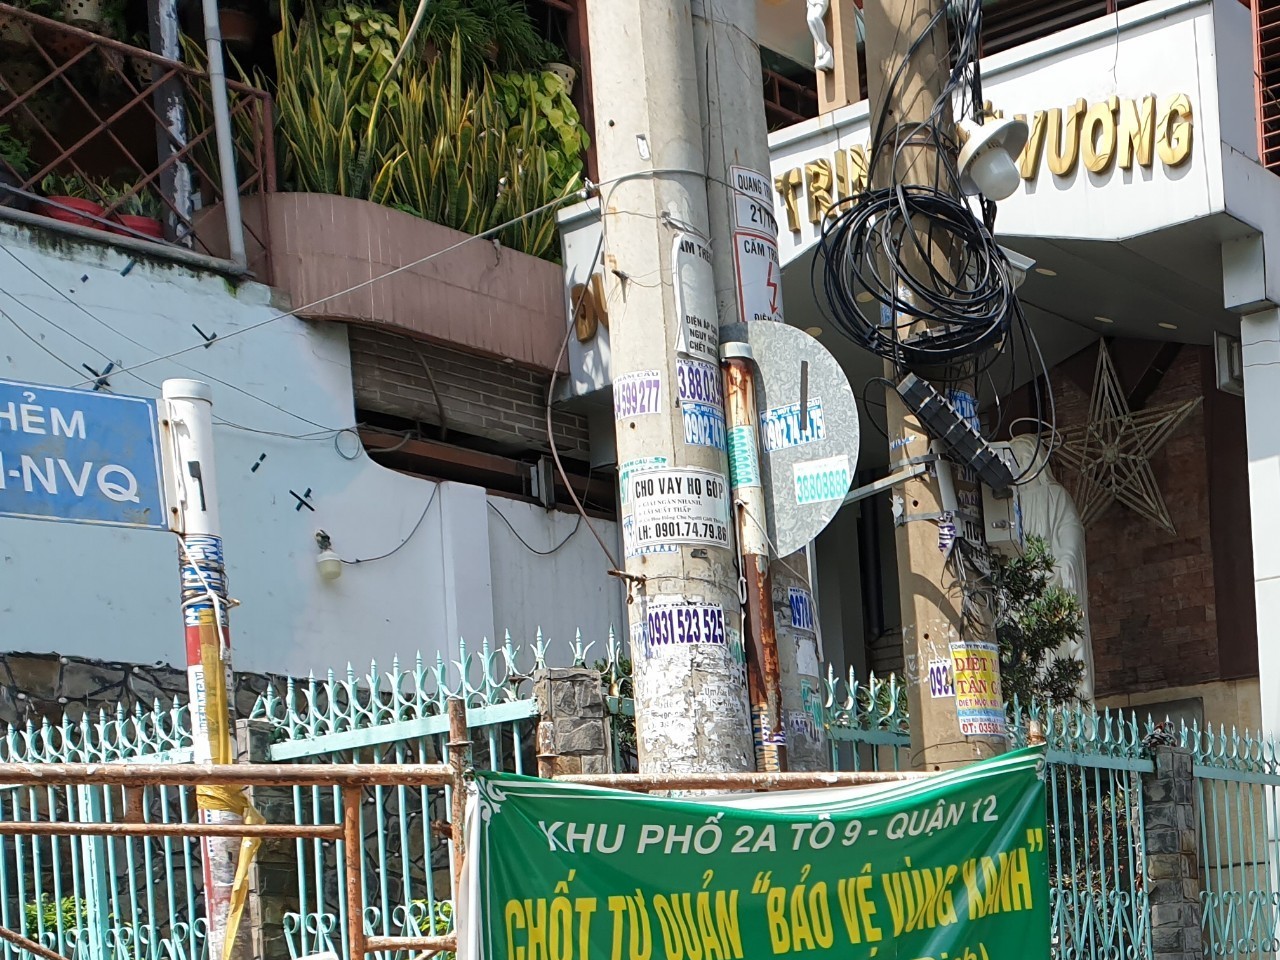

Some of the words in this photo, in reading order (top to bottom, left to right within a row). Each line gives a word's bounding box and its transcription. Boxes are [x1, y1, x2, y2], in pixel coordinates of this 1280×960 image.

[635, 479, 654, 498] CHO
[658, 477, 682, 495] VAY
[687, 478, 702, 499] HỌ
[706, 478, 723, 500] GÓP
[638, 525, 652, 540] LH:
[954, 653, 988, 674] DIỆT
[956, 676, 988, 697] TẬN
[538, 820, 626, 854] KHU
[636, 812, 725, 855] PHỐ
[731, 824, 777, 853] 2A
[841, 819, 862, 847] 9
[885, 799, 967, 840] QUẬN
[971, 794, 999, 822] 12
[837, 862, 883, 958] VỆ
[881, 856, 958, 938] VÙNG
